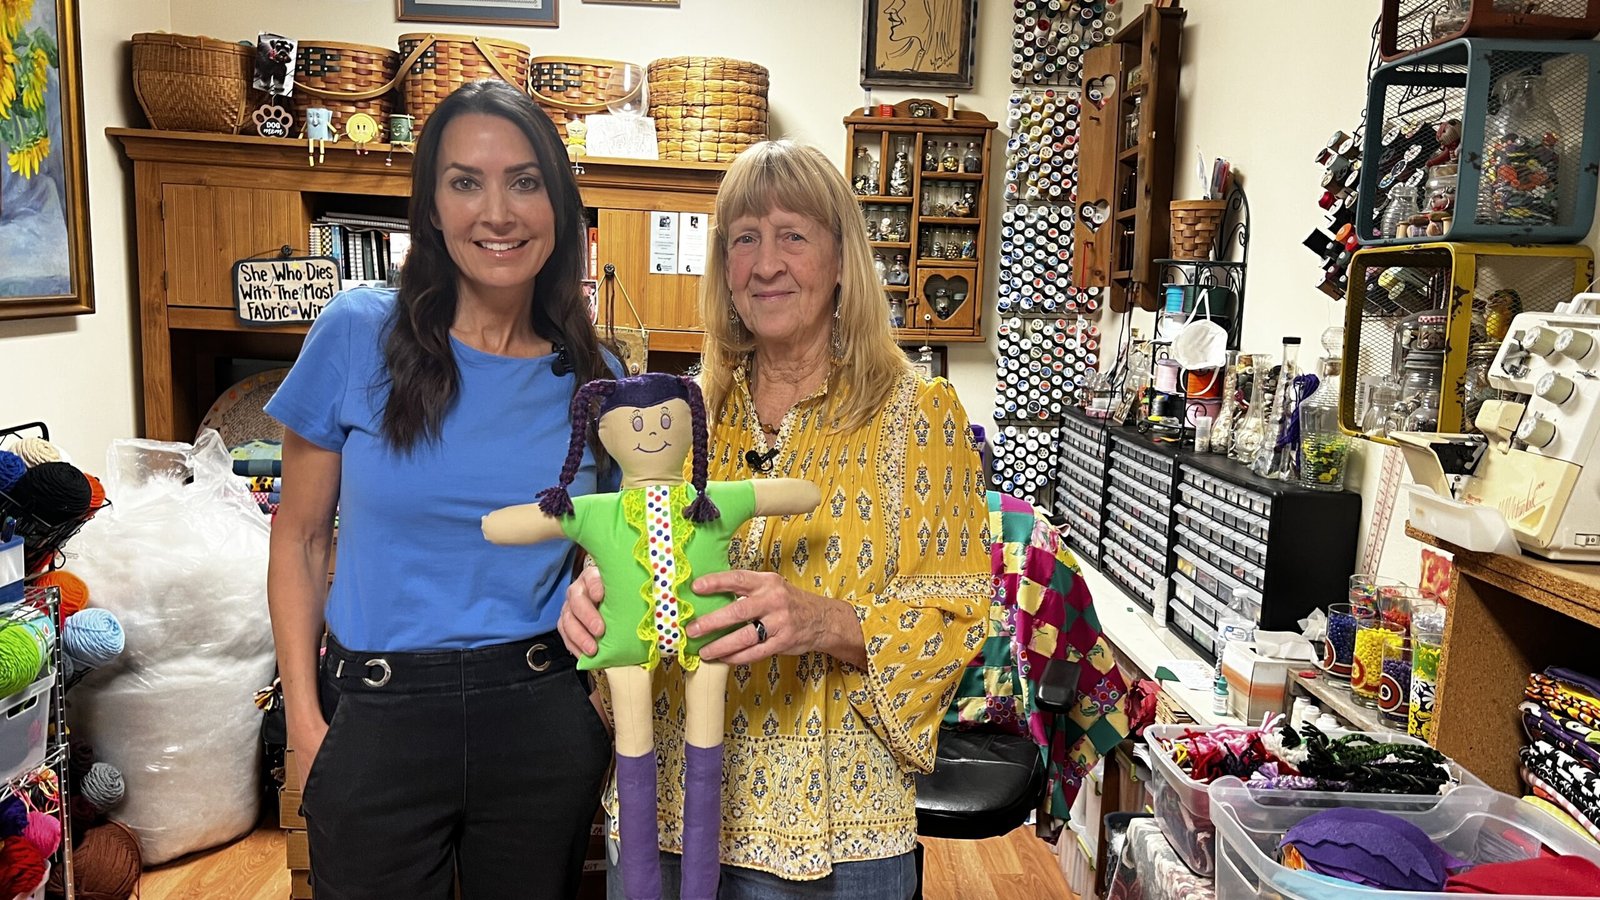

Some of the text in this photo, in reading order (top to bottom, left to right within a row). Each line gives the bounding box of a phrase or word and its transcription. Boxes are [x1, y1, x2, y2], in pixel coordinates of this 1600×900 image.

[240, 262, 334, 282] She Who Dies
[239, 282, 334, 300] With The Most
[298, 301, 324, 319] Win
